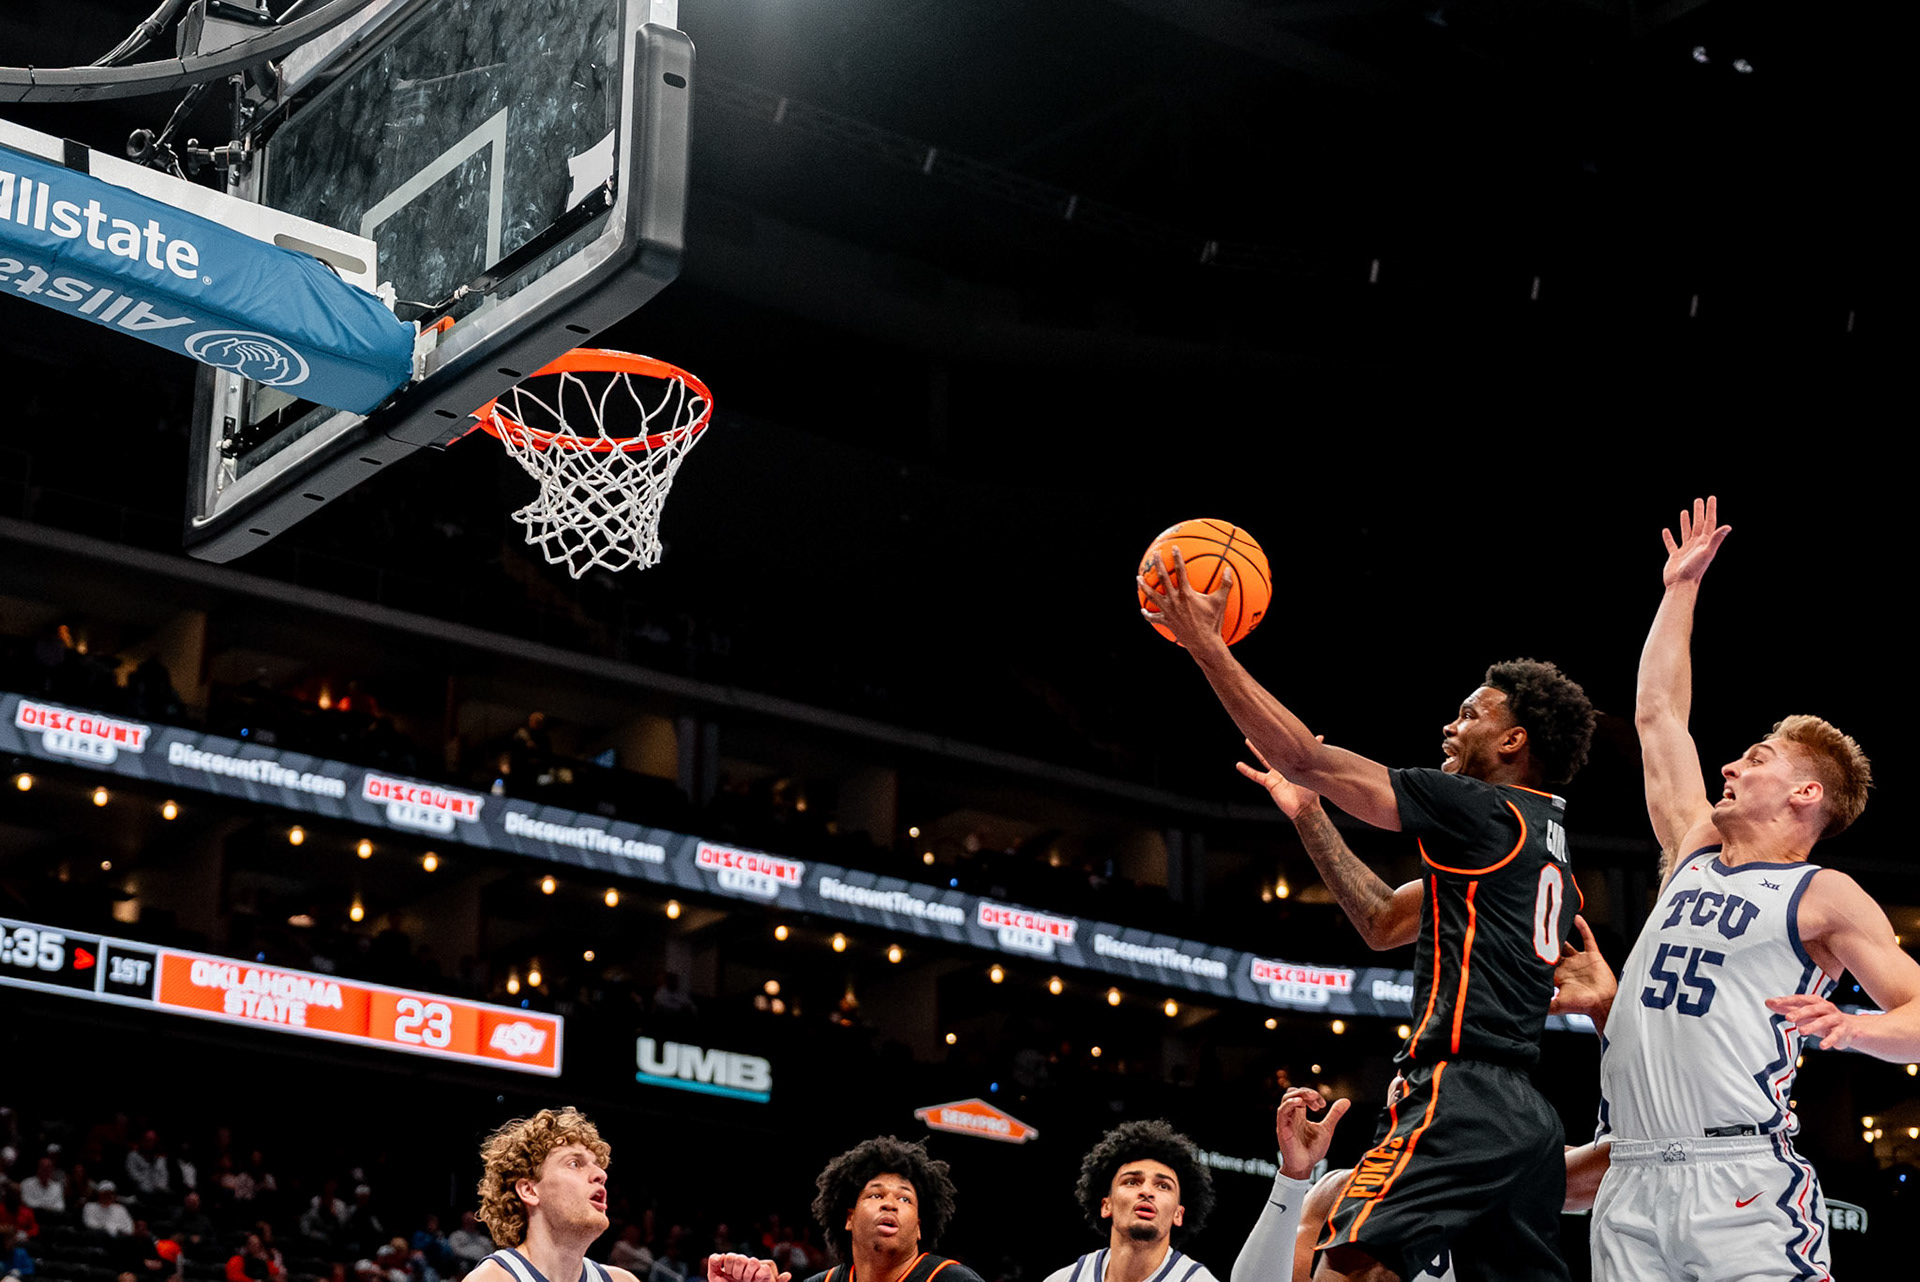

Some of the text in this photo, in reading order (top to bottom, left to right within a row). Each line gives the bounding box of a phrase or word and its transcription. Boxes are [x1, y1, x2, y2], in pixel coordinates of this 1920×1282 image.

[19, 704, 145, 749] DISCOUNT
[168, 742, 346, 798] DiscountTire.com
[365, 777, 479, 818] DISCOUNT
[505, 811, 665, 864] DiscountTire.com
[698, 845, 800, 884] DISCOUNT
[819, 876, 965, 926] DiscountTire.com
[980, 905, 1072, 941] DISCOUNT
[1533, 862, 1564, 965] 0
[1660, 888, 1760, 940] TCU
[109, 956, 150, 986] 1ST
[1094, 933, 1227, 979] DiscountTire.com
[1253, 961, 1349, 990] DISCOUNT
[190, 960, 343, 1009] OKLAHOMA
[1372, 979, 1414, 1003] Disc
[1640, 943, 1725, 1017] 55
[224, 989, 306, 1026] STATE
[395, 998, 452, 1047] 23
[636, 1036, 773, 1091] UMB
[941, 1108, 1010, 1134] SERVPRO
